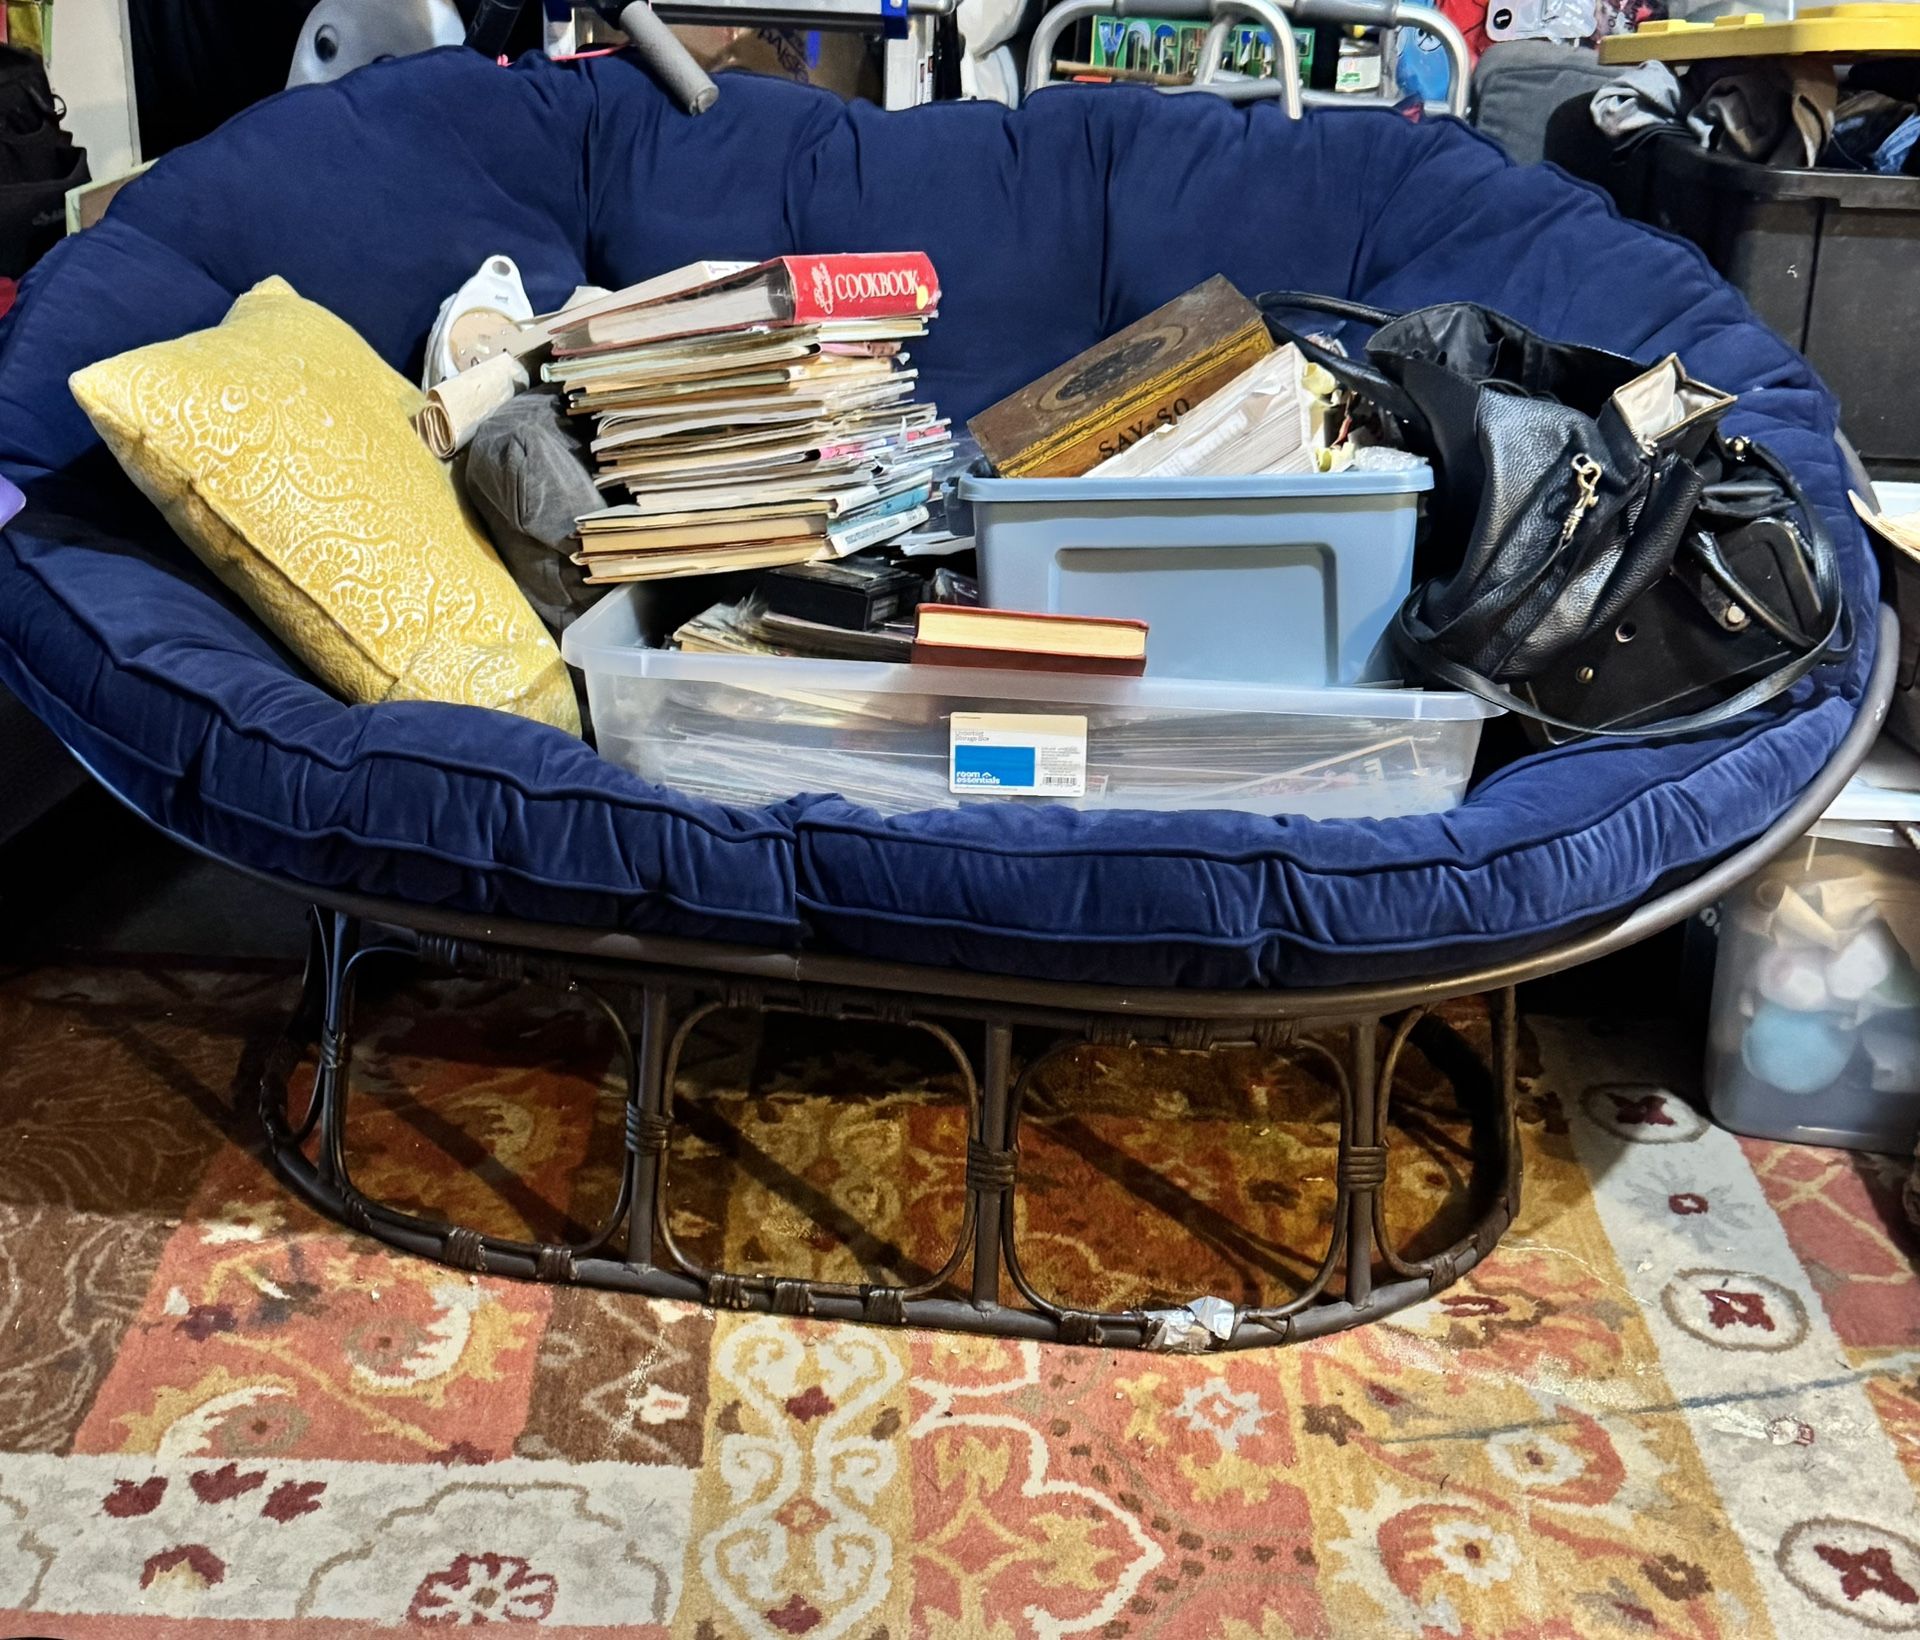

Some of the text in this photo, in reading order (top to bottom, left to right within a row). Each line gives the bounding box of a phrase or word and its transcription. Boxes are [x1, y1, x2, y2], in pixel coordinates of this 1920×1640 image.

[835, 270, 919, 300] COOKBOOK
[1098, 397, 1190, 460] SAY-SO
[956, 776, 1001, 784] essentials
